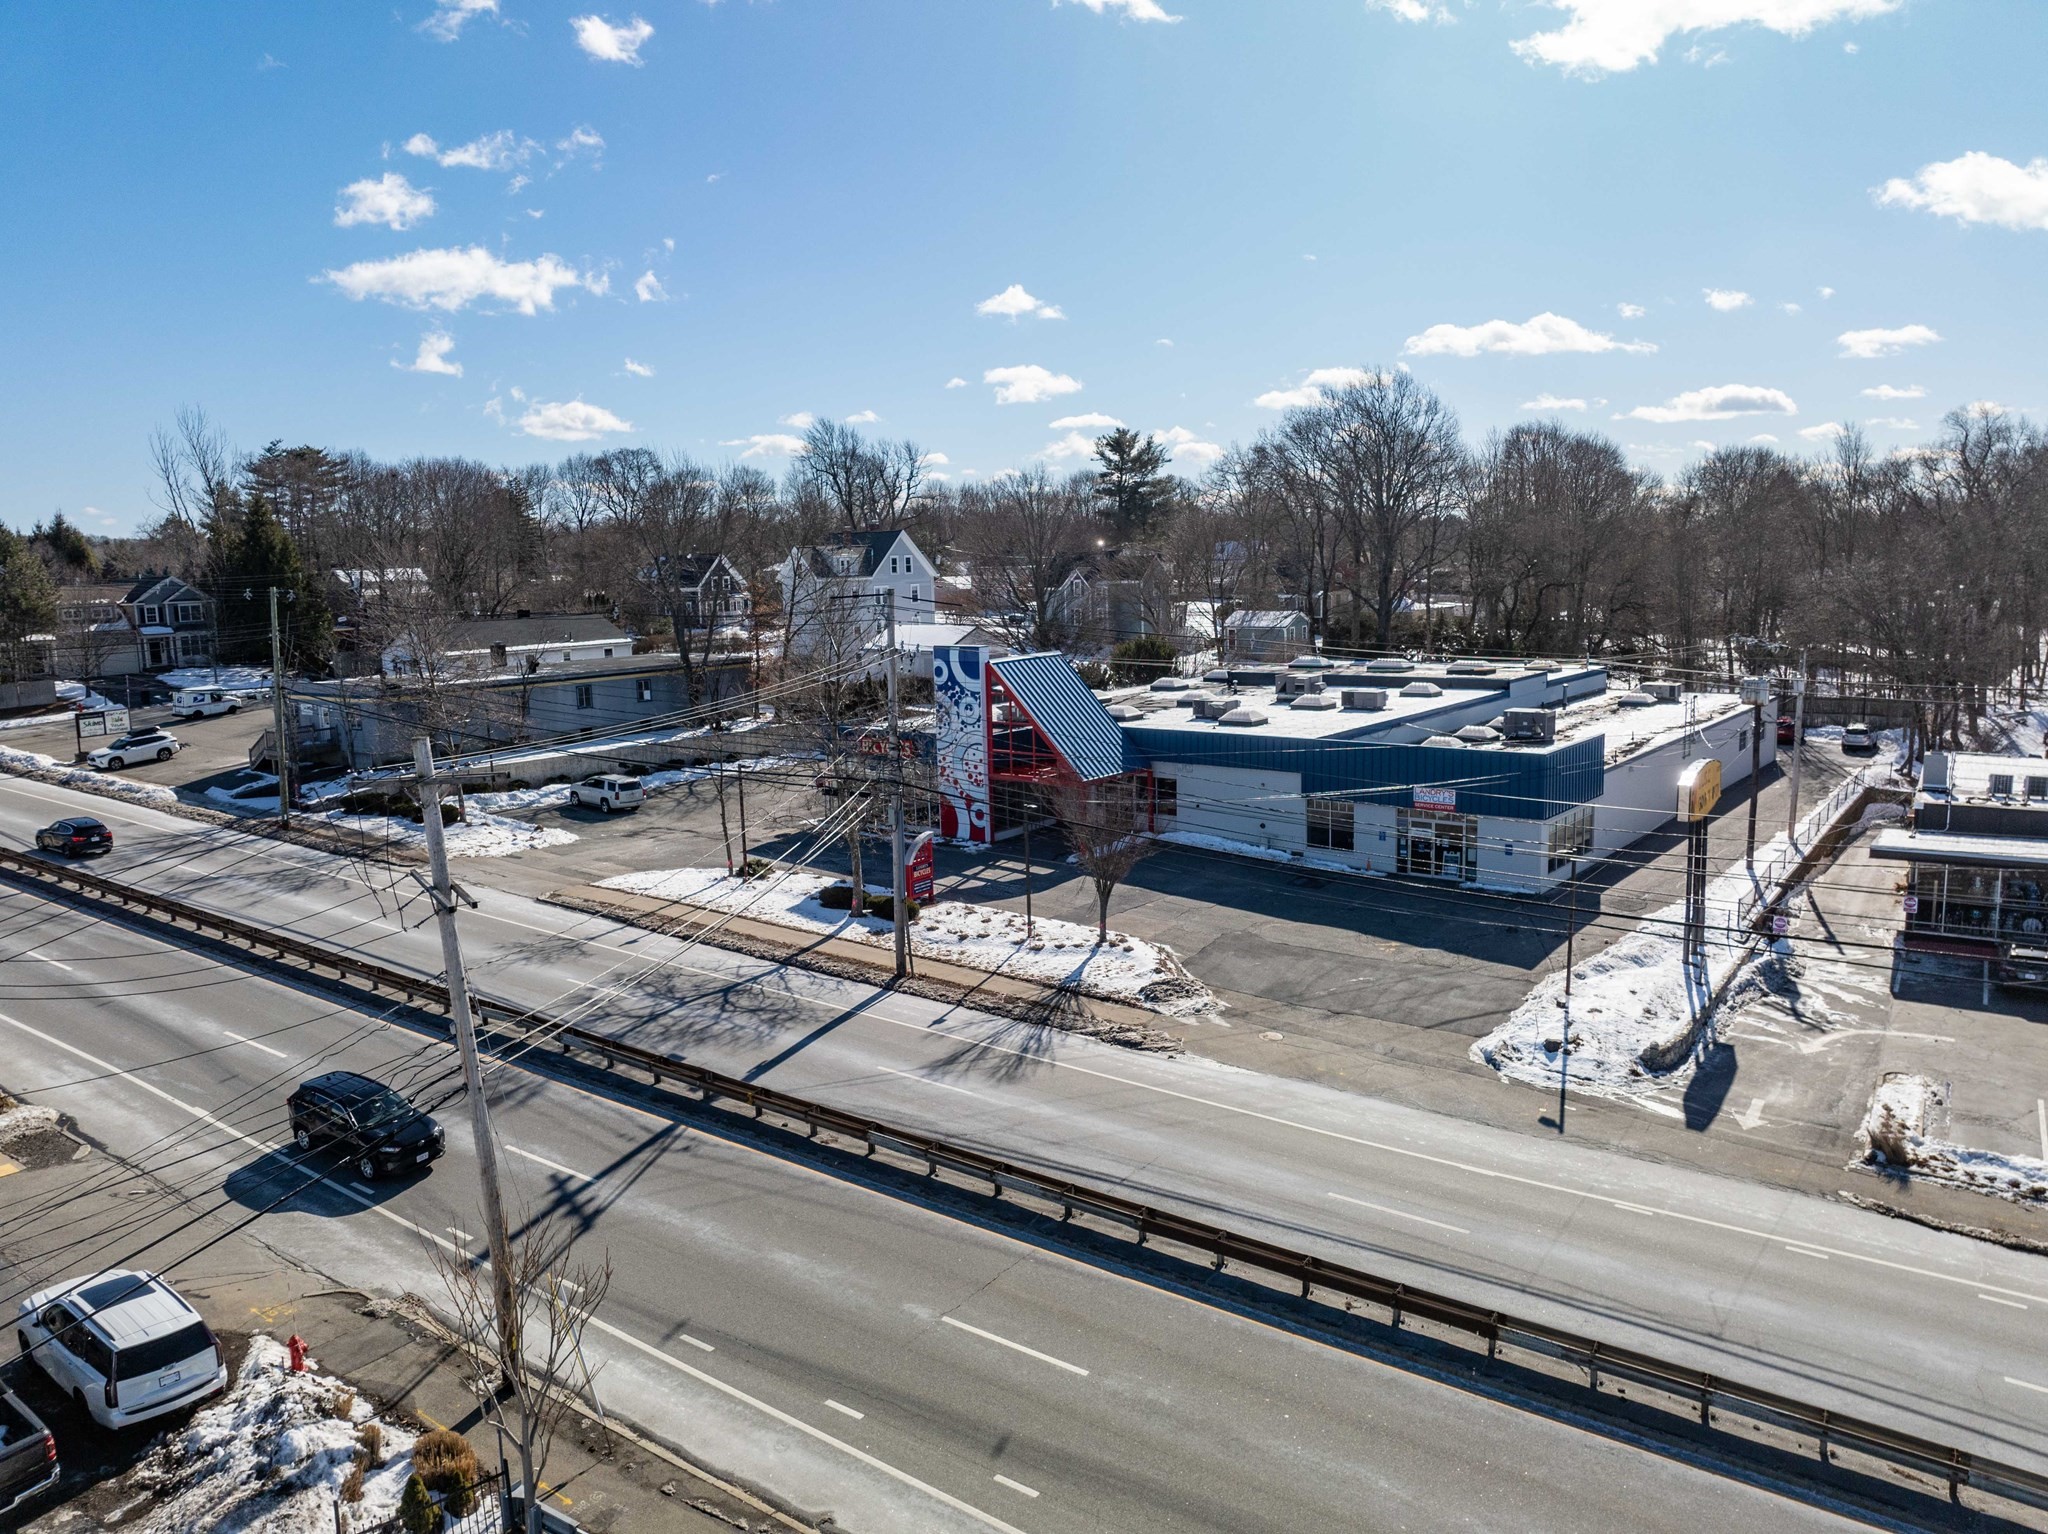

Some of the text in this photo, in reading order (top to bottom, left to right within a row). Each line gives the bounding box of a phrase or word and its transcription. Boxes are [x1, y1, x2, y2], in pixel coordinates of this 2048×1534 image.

[861, 739, 911, 756] BICYS
[1414, 787, 1454, 798] LANDRY'S
[1414, 794, 1454, 804] BICYCLES
[913, 867, 931, 878] BICYCLES
